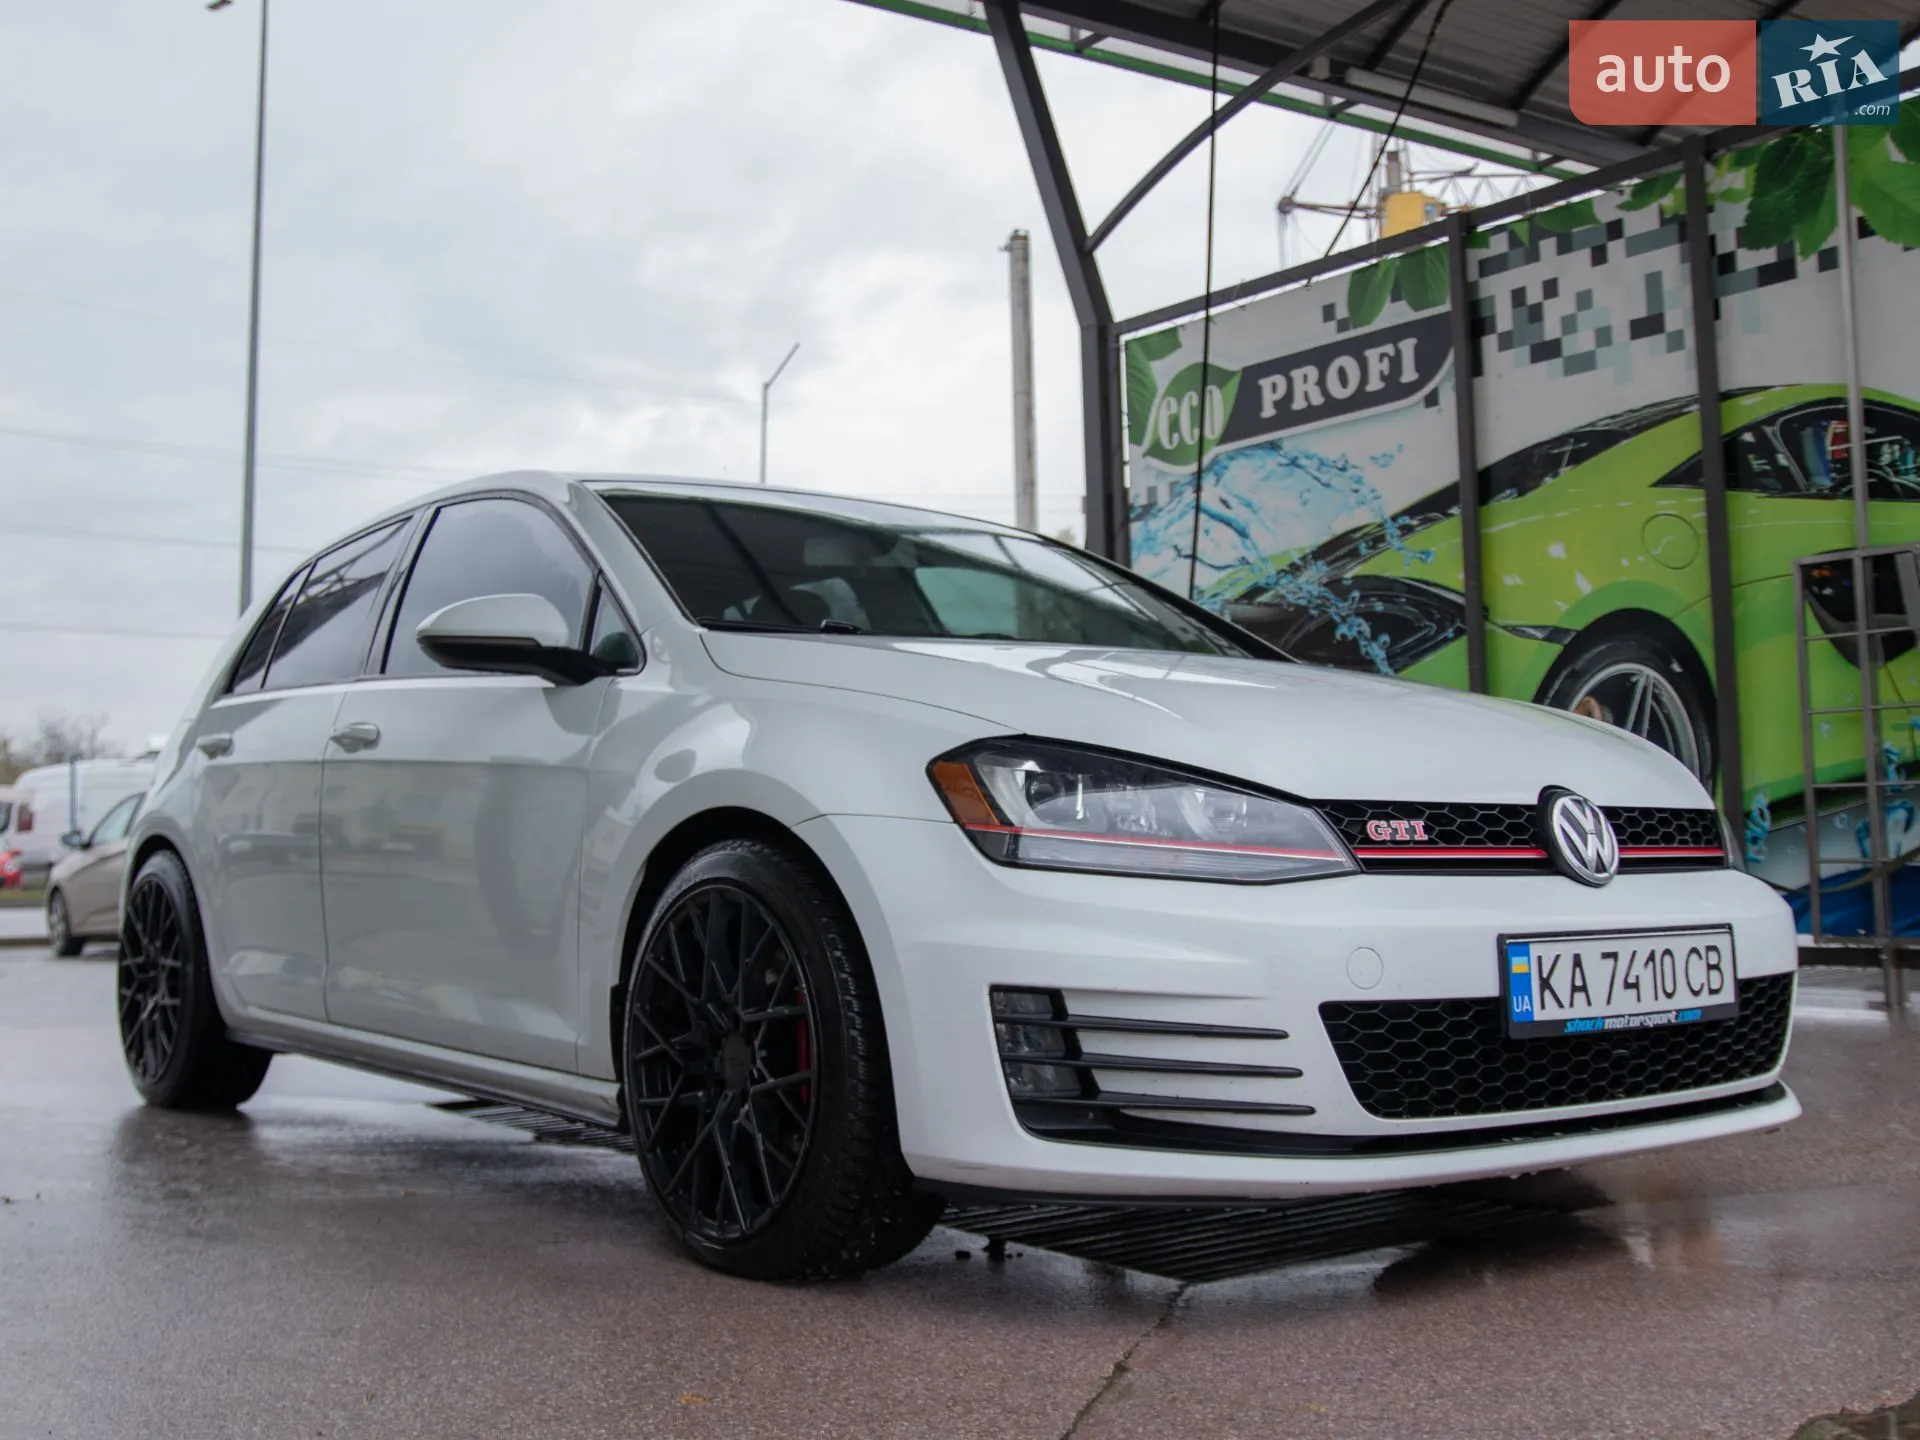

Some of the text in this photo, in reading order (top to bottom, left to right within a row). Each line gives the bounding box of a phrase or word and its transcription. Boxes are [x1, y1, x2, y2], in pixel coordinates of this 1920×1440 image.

[1157, 337, 1420, 450] eco PROFI
[1366, 819, 1429, 841] GTI
[1536, 944, 1724, 1010] KA 7410 CB
[1513, 995, 1532, 1013] UA
